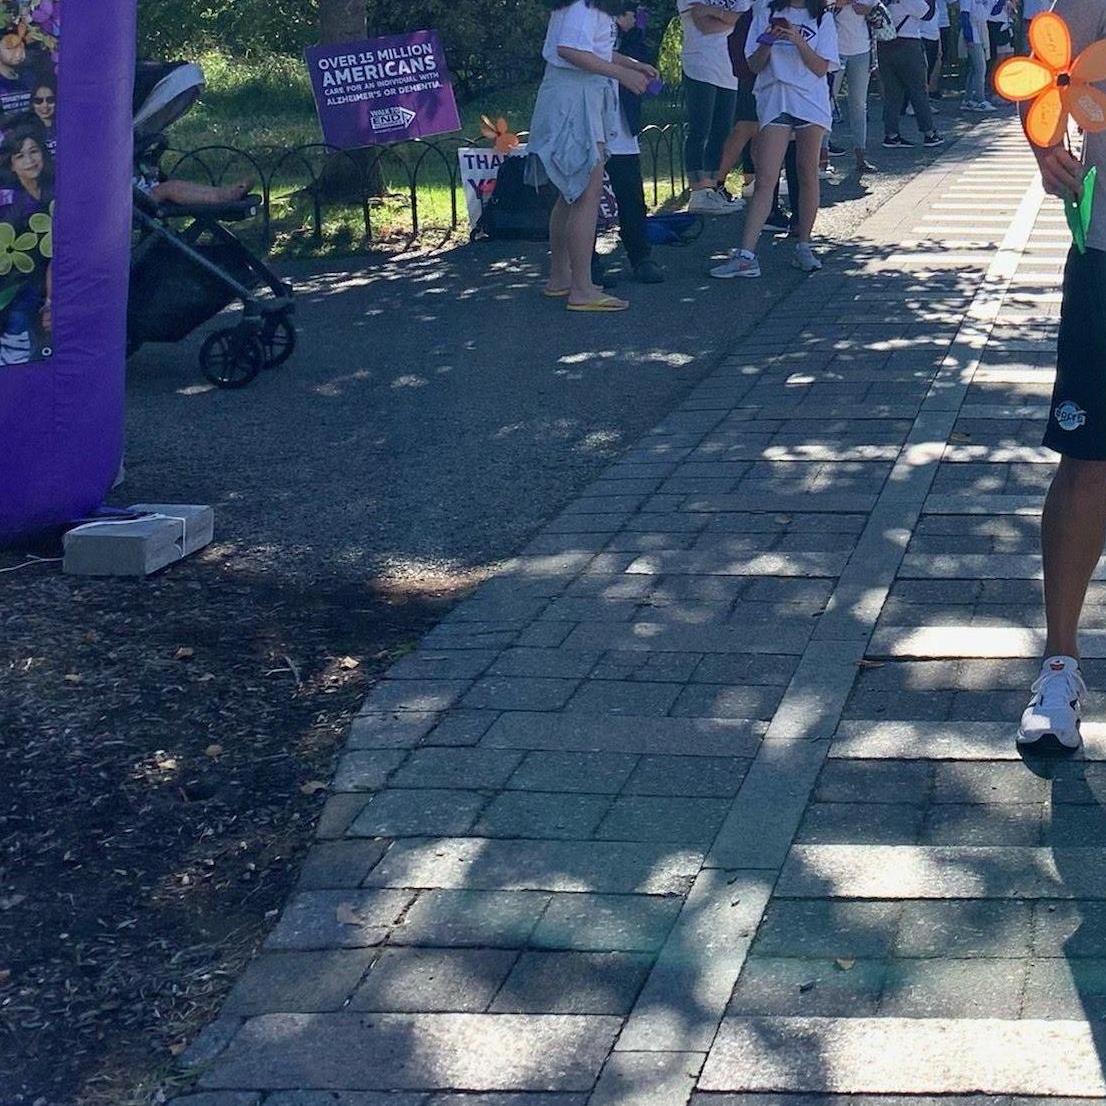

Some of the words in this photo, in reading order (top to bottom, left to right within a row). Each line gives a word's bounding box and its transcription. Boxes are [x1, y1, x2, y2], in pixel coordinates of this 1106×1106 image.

[318, 54, 357, 70] OVER
[358, 51, 374, 64] 15
[377, 43, 433, 61] MILLION
[323, 55, 437, 87] AMERICANS
[324, 86, 345, 96] CARE
[346, 84, 362, 92] FOR
[364, 81, 375, 89] AN
[376, 75, 418, 88] INDIVIDUAL
[419, 72, 439, 81] WITH
[327, 90, 381, 106] ALZHEIMER'S
[383, 88, 397, 97] OR
[463, 154, 507, 170] THA
